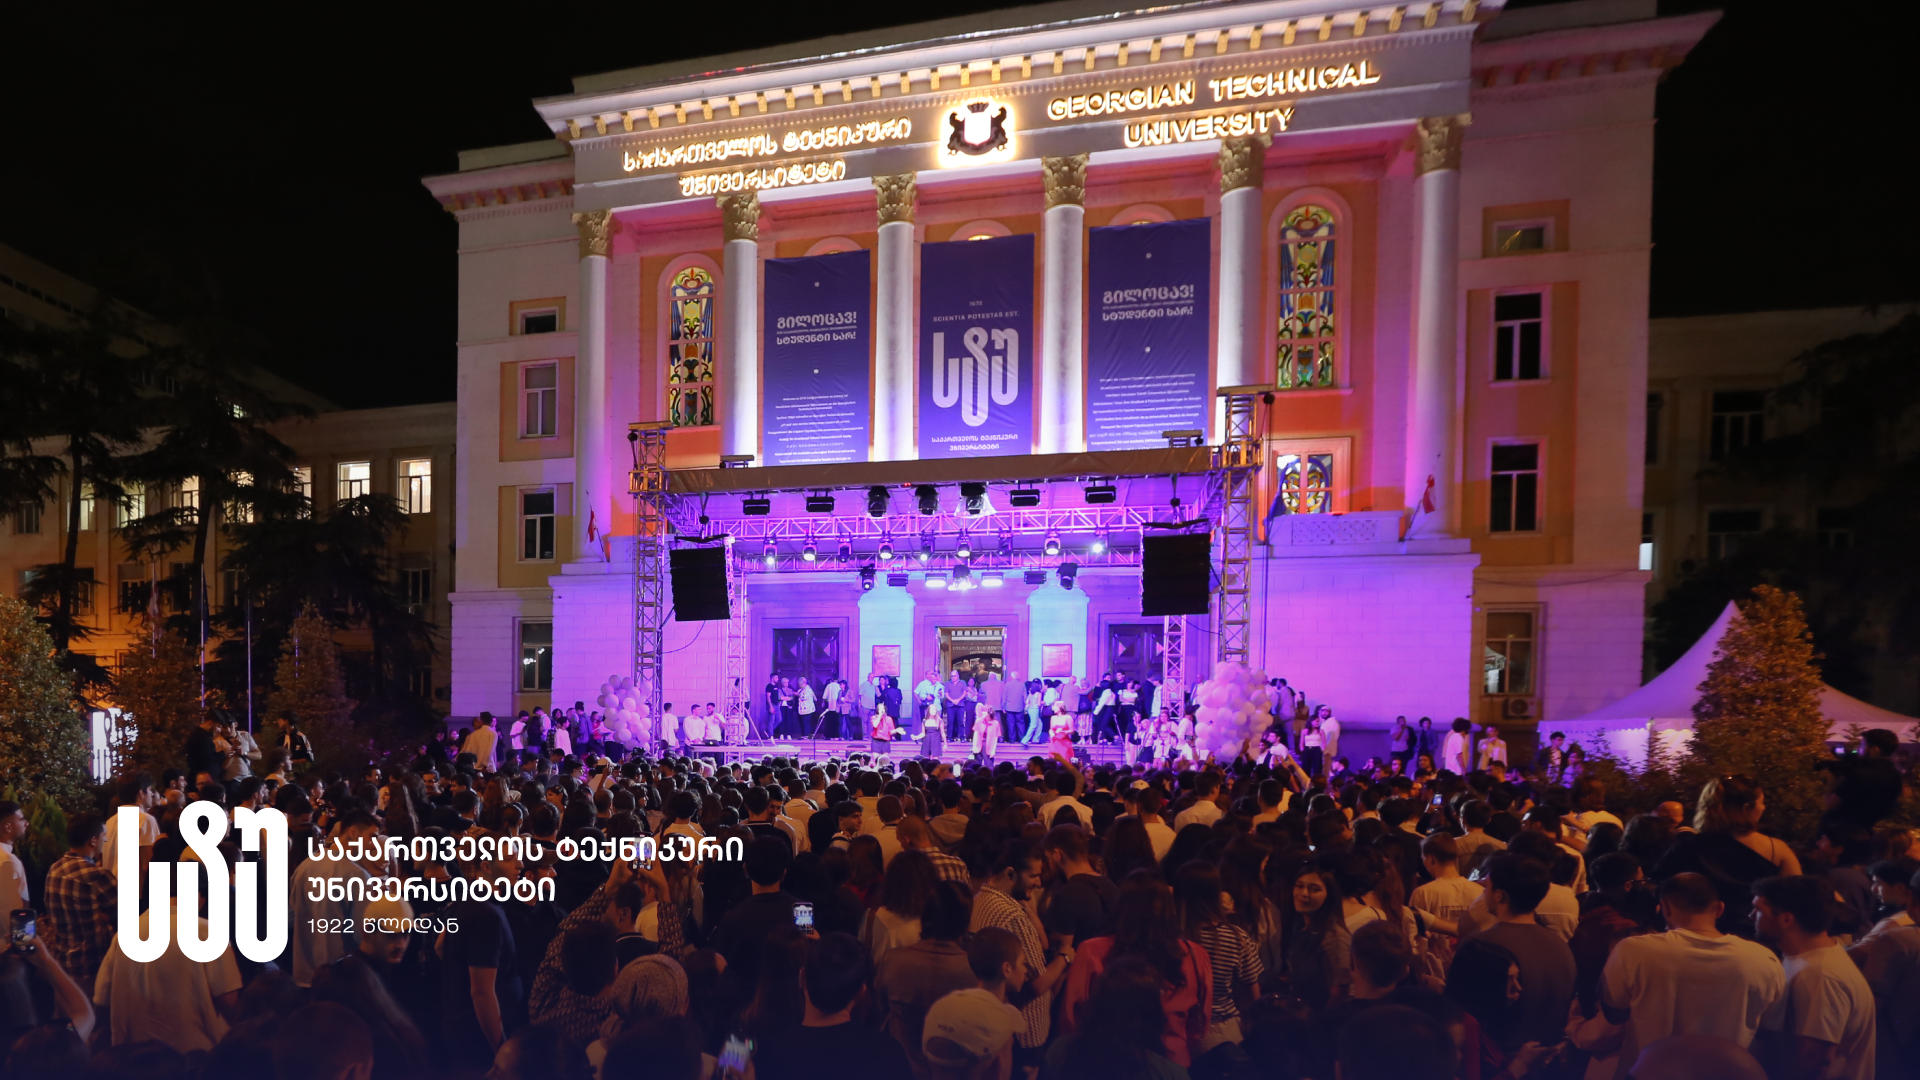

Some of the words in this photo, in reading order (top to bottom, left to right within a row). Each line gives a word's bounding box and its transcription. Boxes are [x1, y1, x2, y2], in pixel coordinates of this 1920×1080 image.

[1047, 79, 1197, 121] GEORGIAN
[1208, 59, 1381, 101] TECHNICAL
[782, 116, 912, 152] ტექნიკური
[1122, 105, 1295, 149] UNIVERSITY
[679, 158, 847, 197] უნივერსიტეტი
[1102, 284, 1195, 304] გილოცავ!
[777, 311, 857, 329] გილოცავ!
